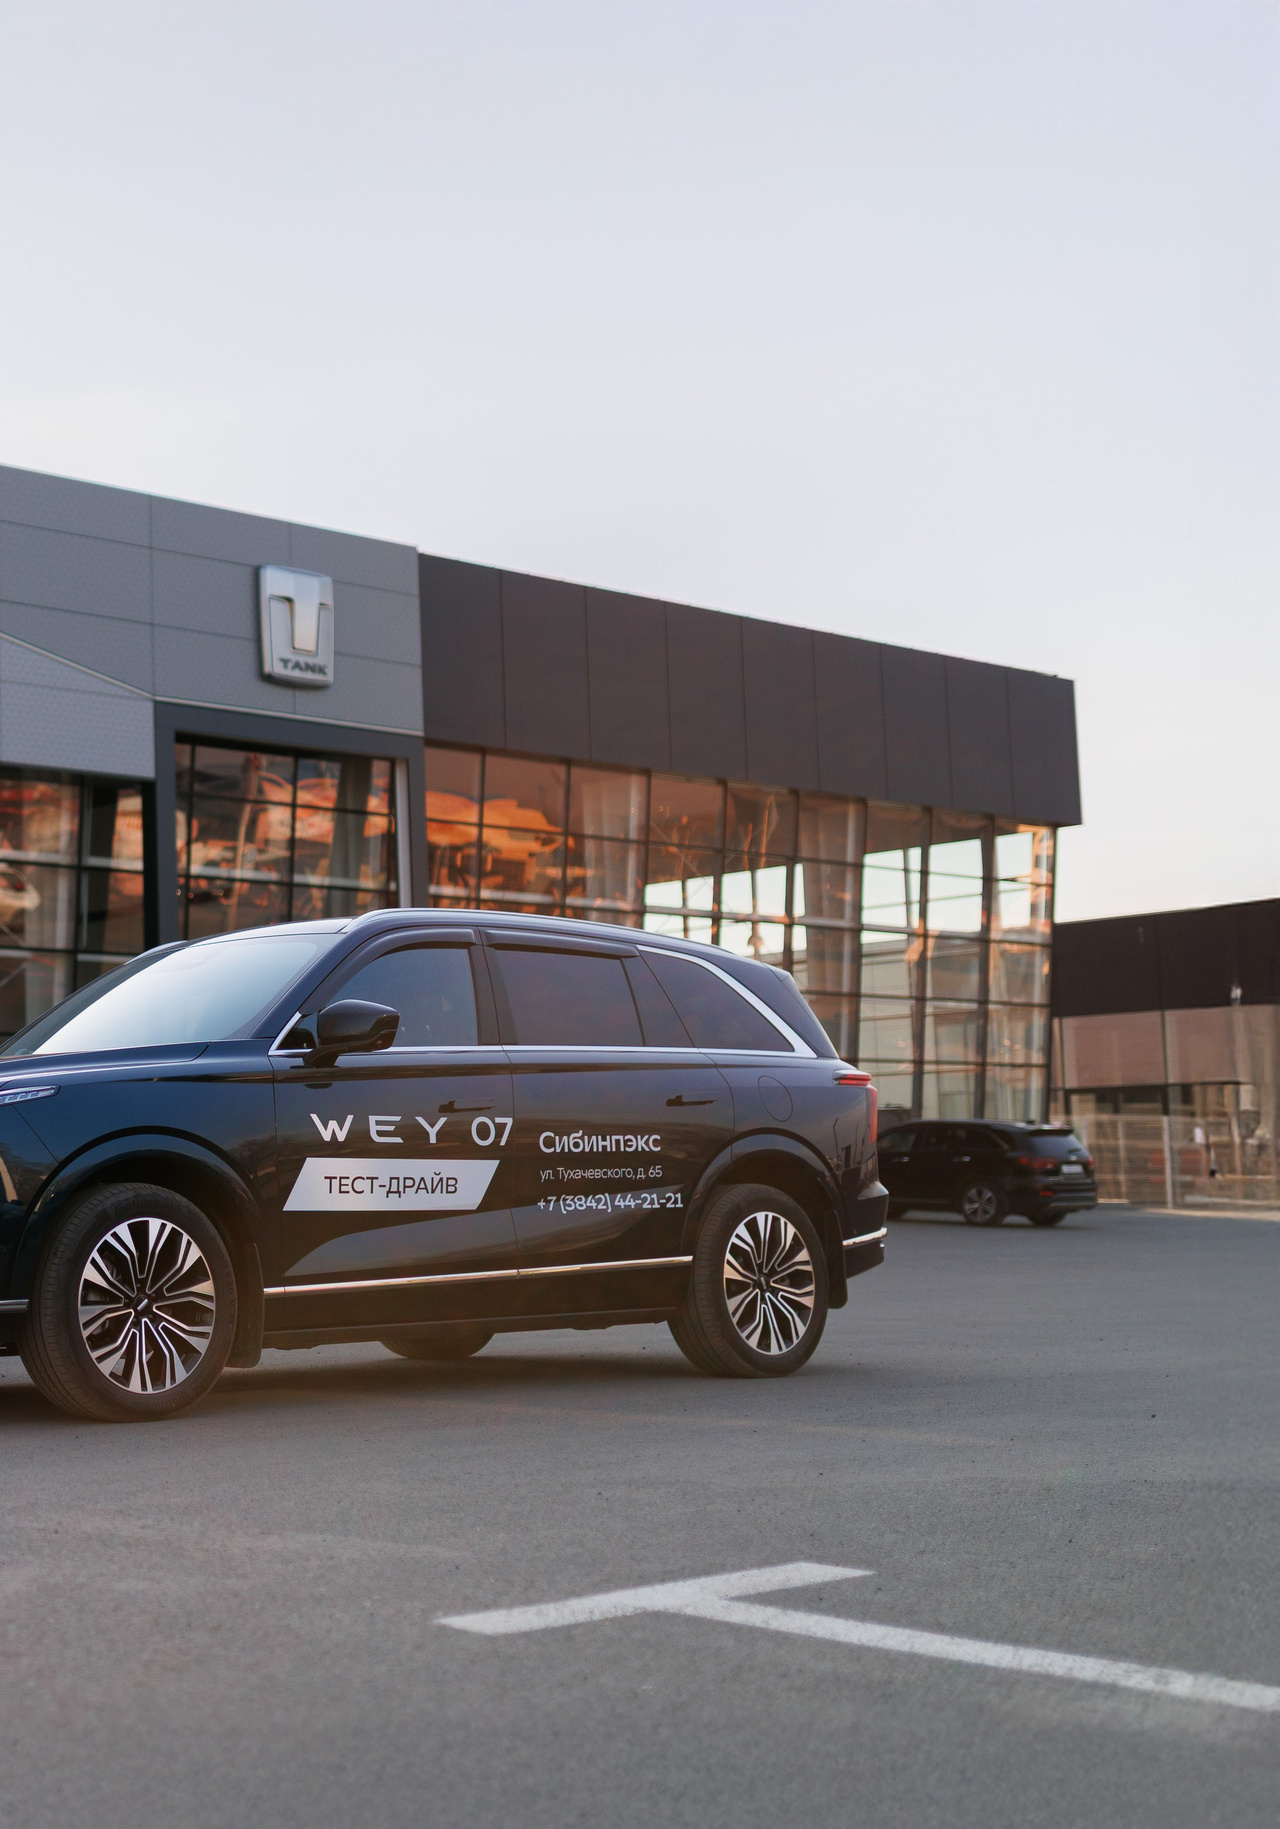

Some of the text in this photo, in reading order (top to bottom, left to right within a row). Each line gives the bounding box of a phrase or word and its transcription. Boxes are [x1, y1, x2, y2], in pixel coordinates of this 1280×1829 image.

[279, 657, 328, 677] TANK
[310, 1113, 513, 1147] WEY 07
[539, 1130, 661, 1153] Сибинпэкс
[324, 1171, 458, 1198] ТЕСТ-ДРАЙВ
[539, 1169, 554, 1182] ул.
[557, 1167, 635, 1182] Тухачевского,
[648, 1166, 663, 1178] 65
[537, 1192, 683, 1214] +7 (3842) 44-21-21
